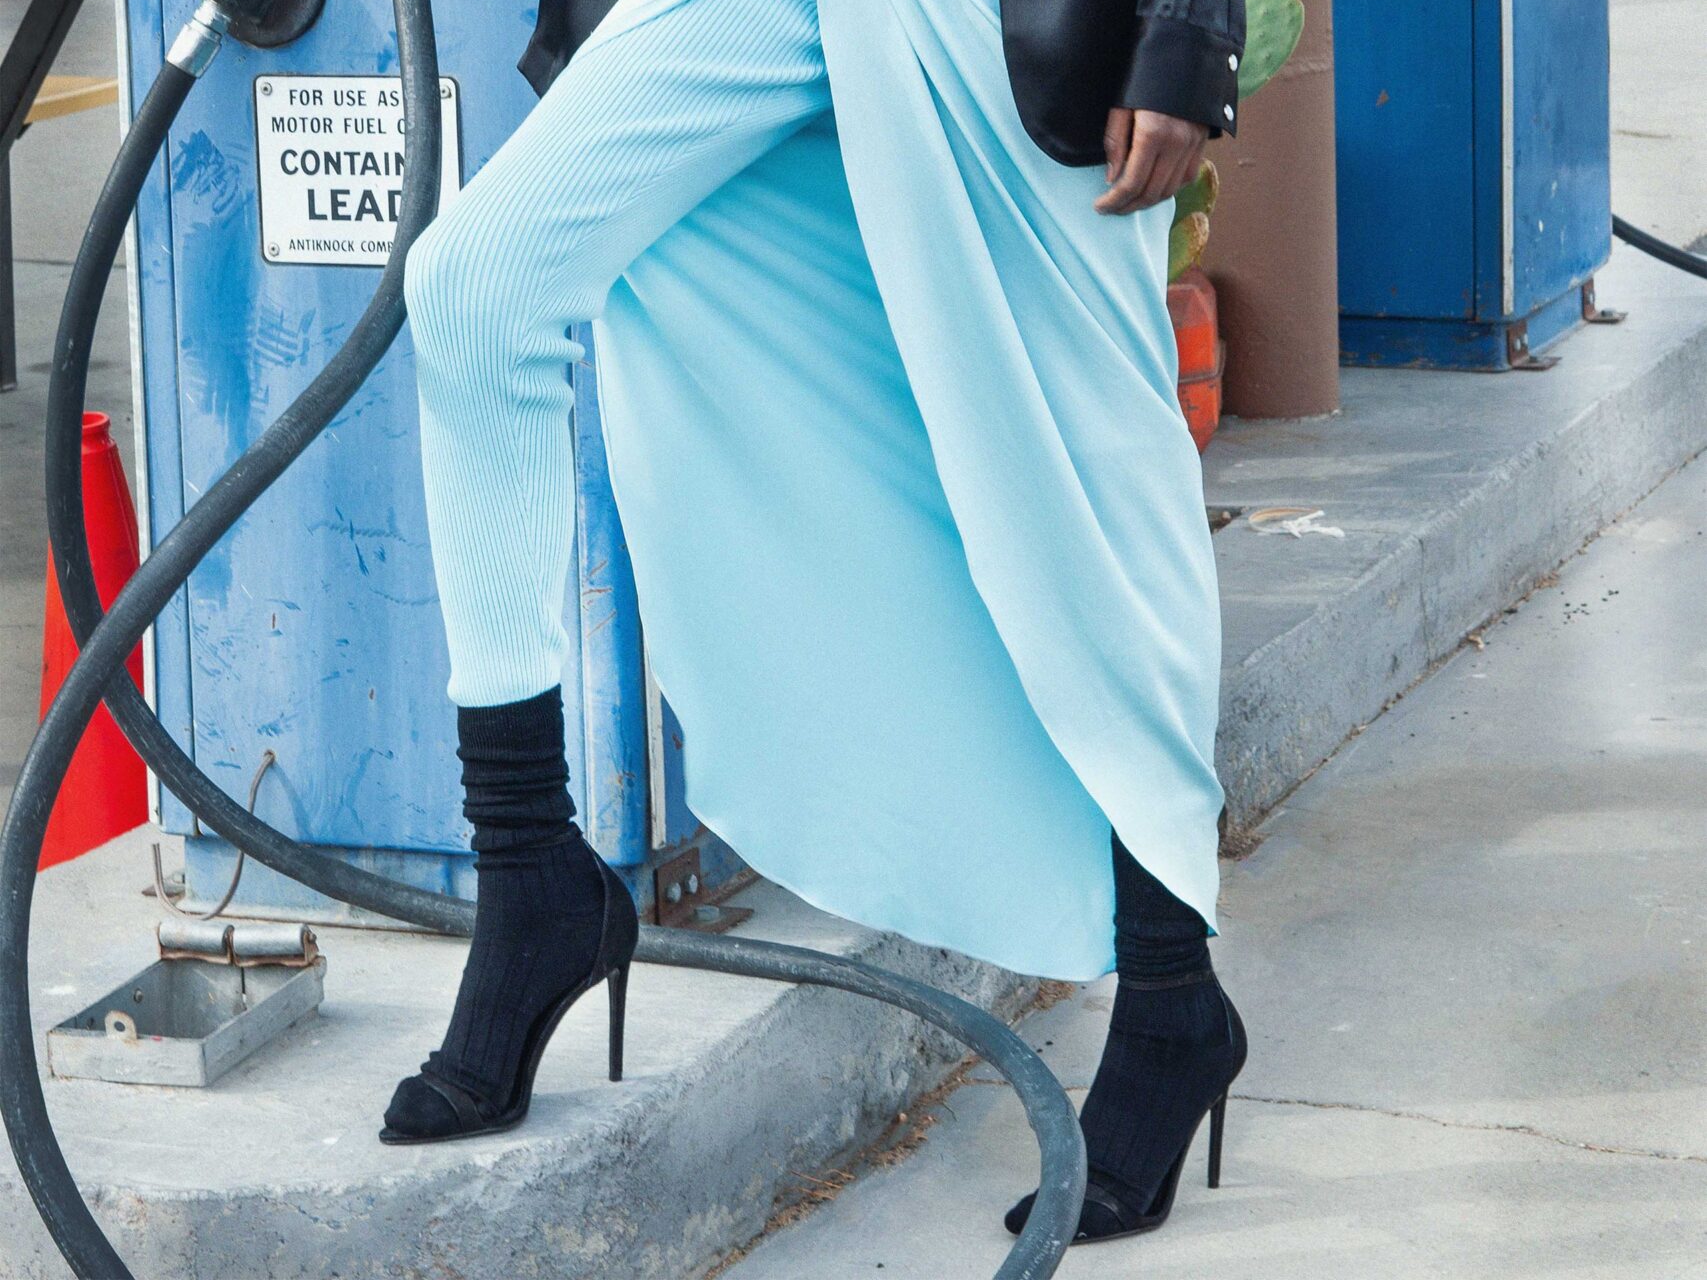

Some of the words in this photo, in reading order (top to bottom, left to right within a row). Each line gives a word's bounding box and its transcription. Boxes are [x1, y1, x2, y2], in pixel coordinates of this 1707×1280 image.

[289, 89, 323, 107] FOR
[333, 89, 367, 107] USE
[377, 90, 400, 107] AS
[271, 116, 334, 134] MOTOR
[344, 117, 387, 135] FUEL
[280, 148, 406, 176] CONTAIN
[288, 238, 355, 253] ANTIKNOCK
